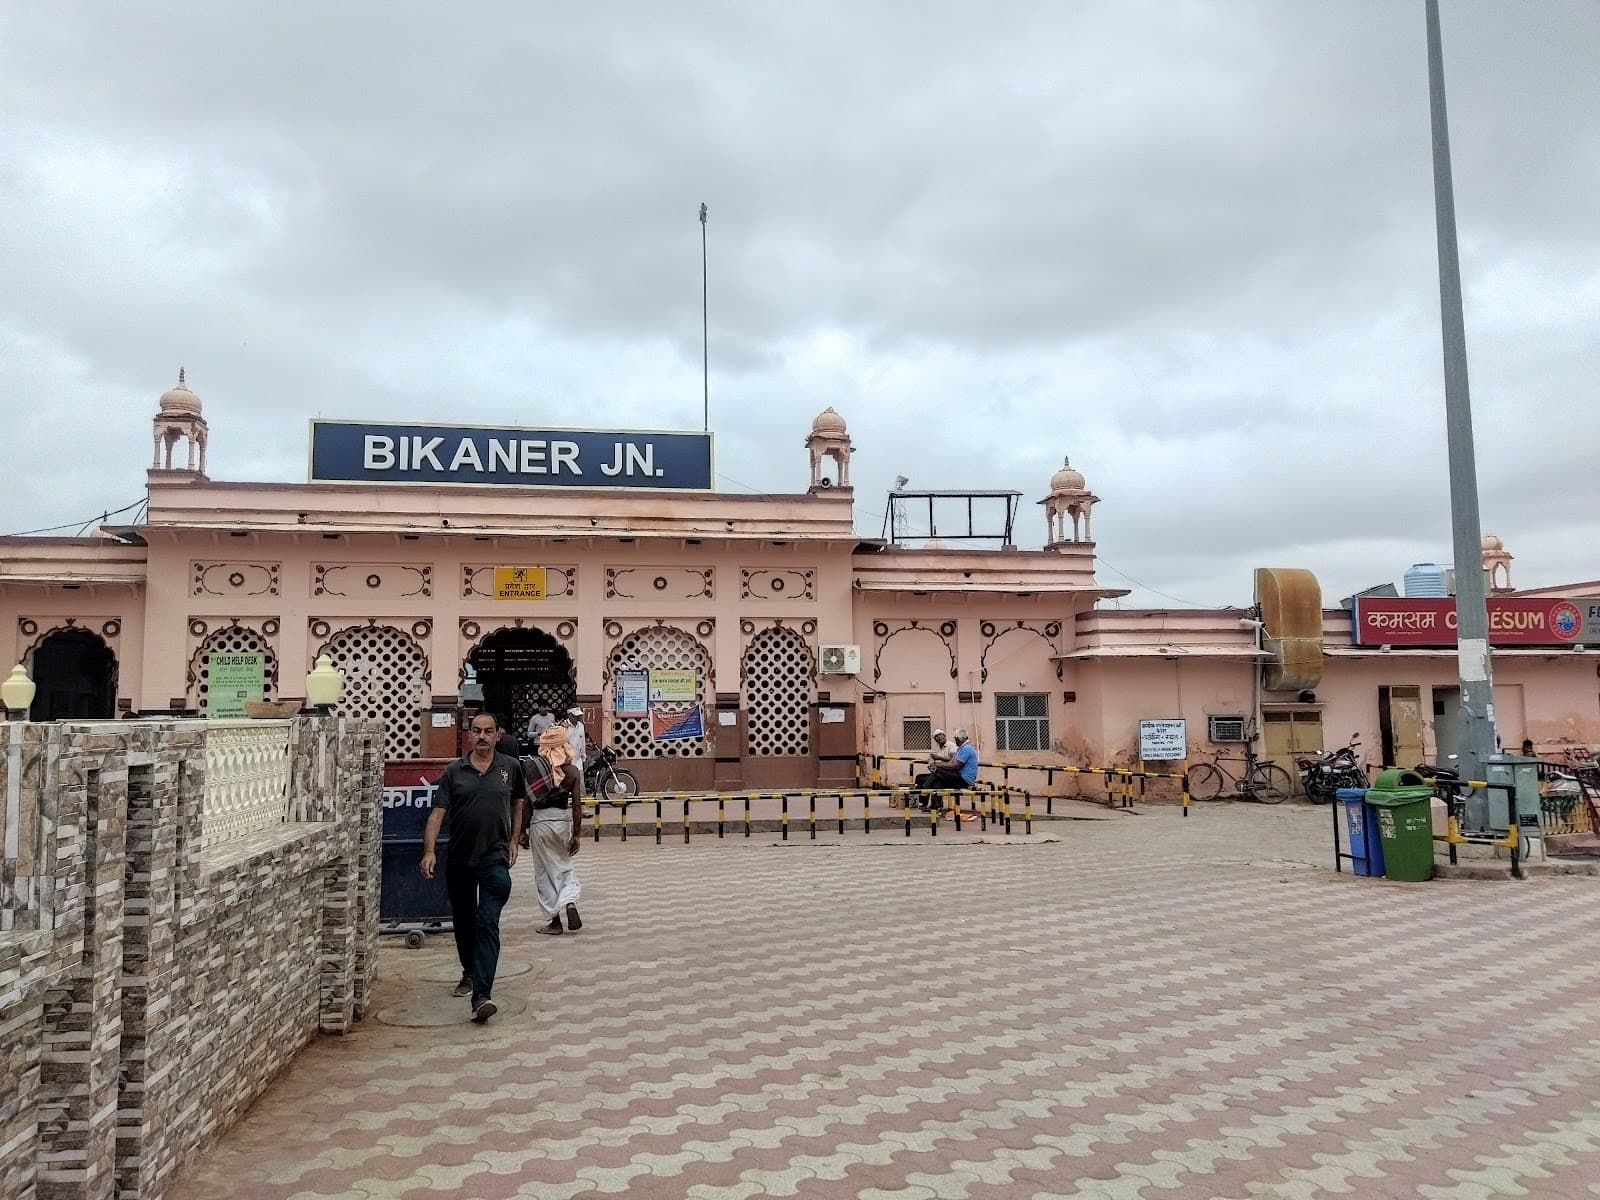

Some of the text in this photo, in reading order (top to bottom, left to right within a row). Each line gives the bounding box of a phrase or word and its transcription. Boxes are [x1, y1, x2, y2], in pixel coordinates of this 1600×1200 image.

[363, 434, 665, 478] BIKANER JN.
[216, 655, 258, 666] CHILD HELP DESK
